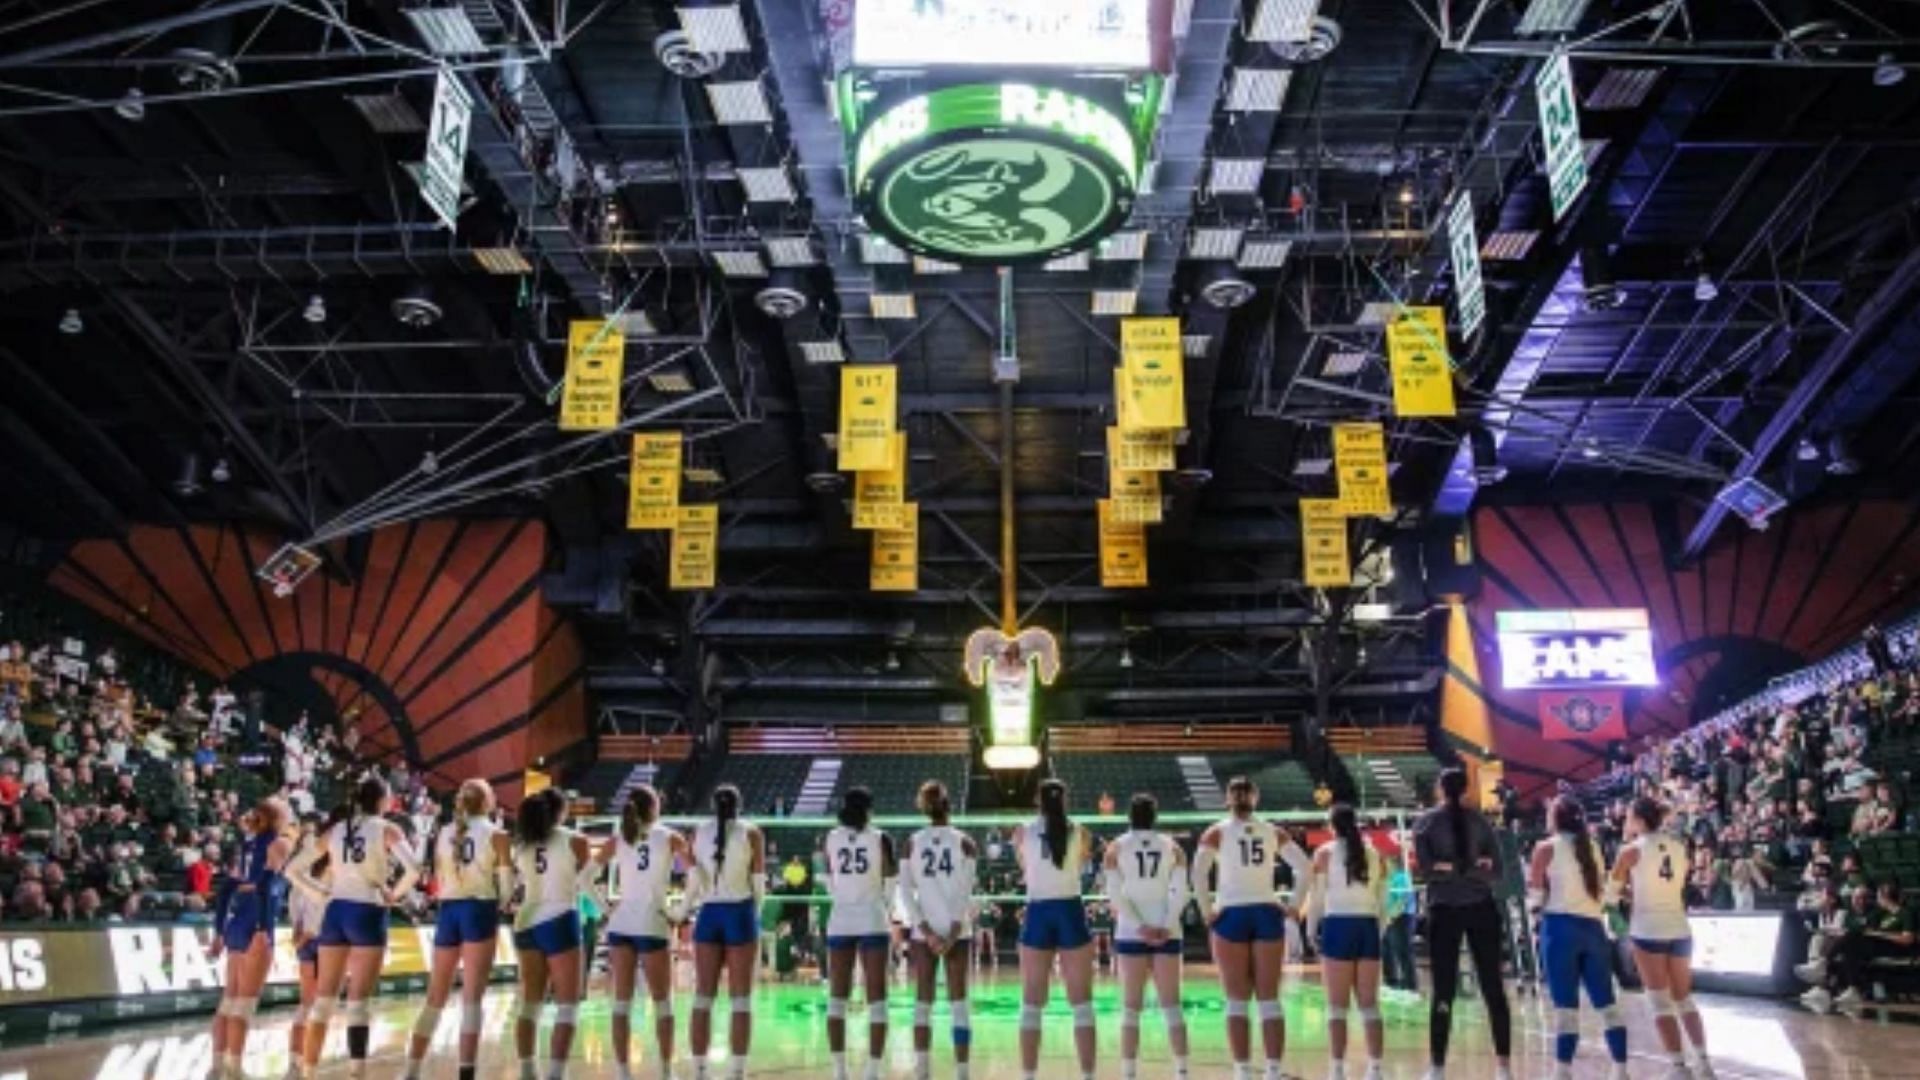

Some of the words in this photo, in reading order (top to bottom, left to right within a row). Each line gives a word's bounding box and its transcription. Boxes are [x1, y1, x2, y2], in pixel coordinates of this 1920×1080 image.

[1546, 84, 1574, 148] 24
[438, 102, 464, 162] 14
[534, 847, 548, 875] 5
[637, 844, 650, 871] 3
[837, 846, 869, 874] 25
[921, 846, 954, 877] 24
[1135, 851, 1162, 878] 17
[1238, 837, 1264, 867] 15
[1658, 853, 1674, 882] 4
